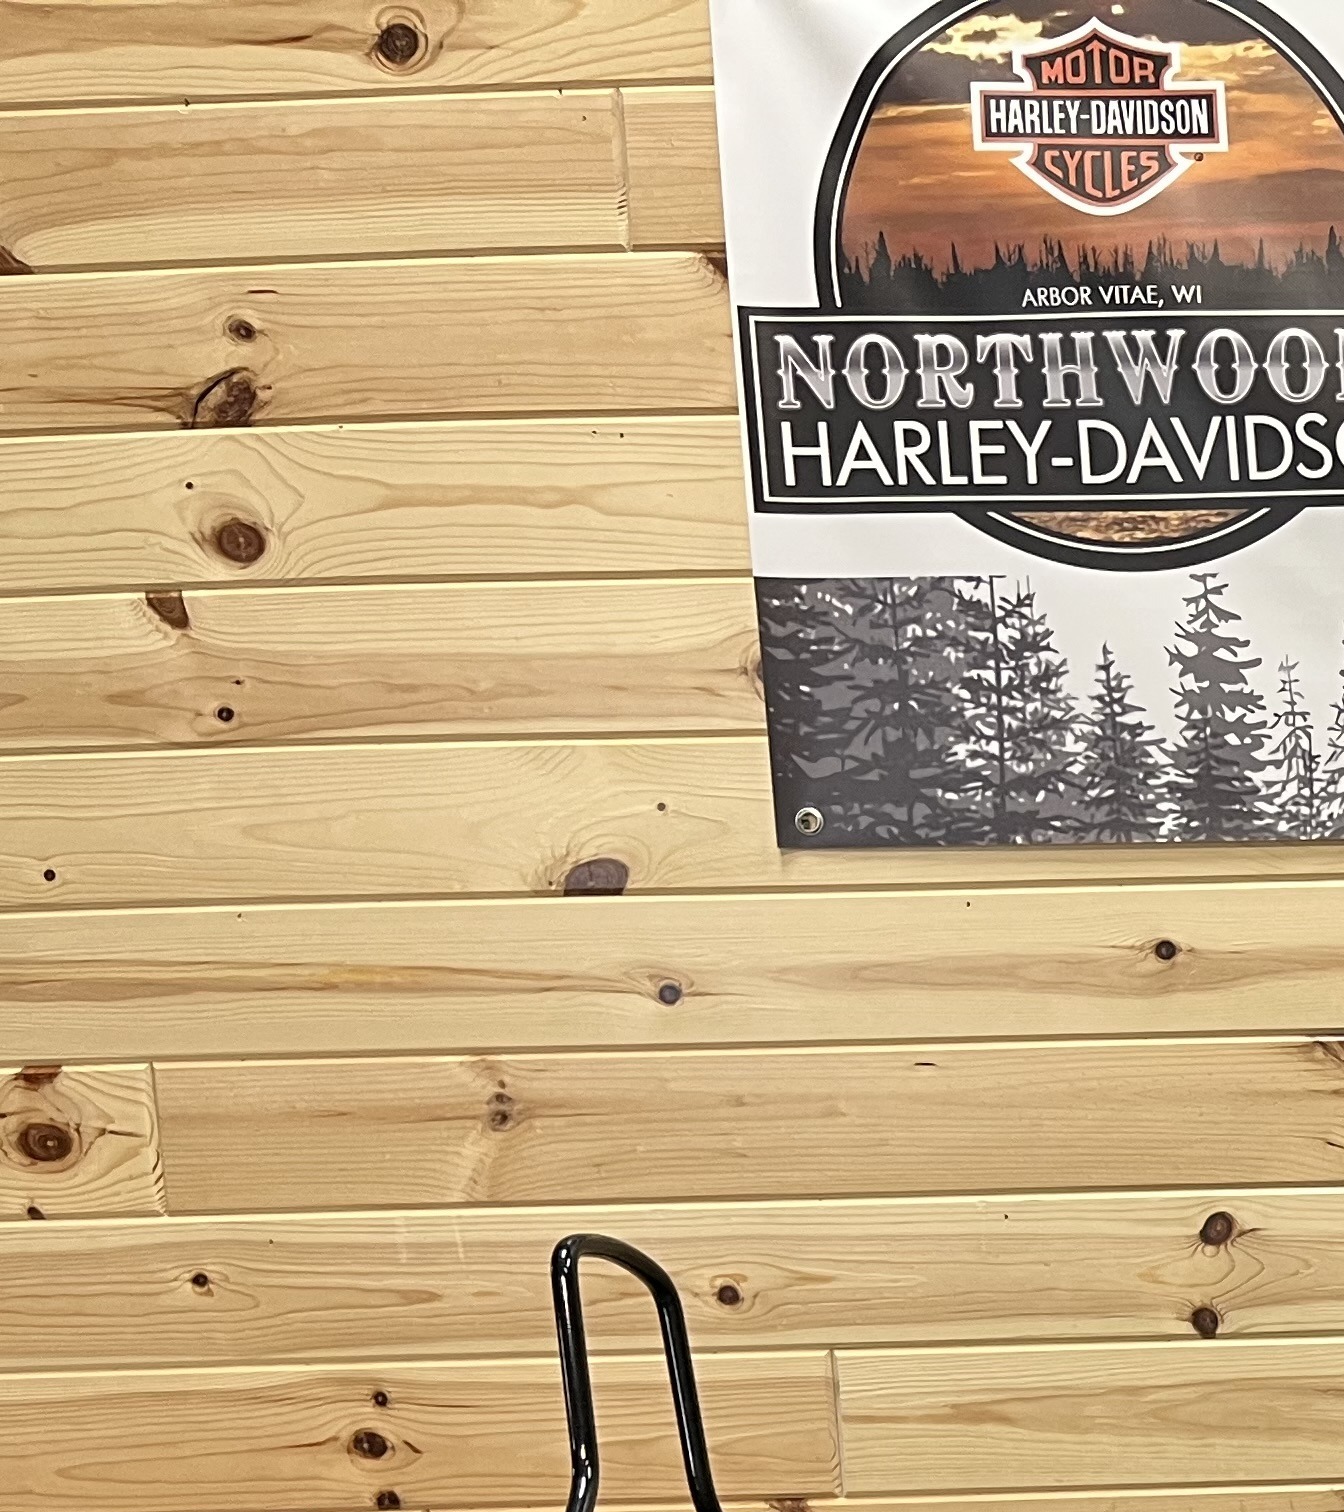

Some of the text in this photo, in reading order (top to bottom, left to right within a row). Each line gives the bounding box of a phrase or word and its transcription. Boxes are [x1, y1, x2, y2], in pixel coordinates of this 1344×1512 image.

[1041, 40, 1156, 85] MOTOR
[989, 98, 1210, 136] HARLEY-DAVIDSON
[1044, 150, 1160, 199] CYCLES
[1022, 284, 1203, 310] ARBOR VITAE, WI
